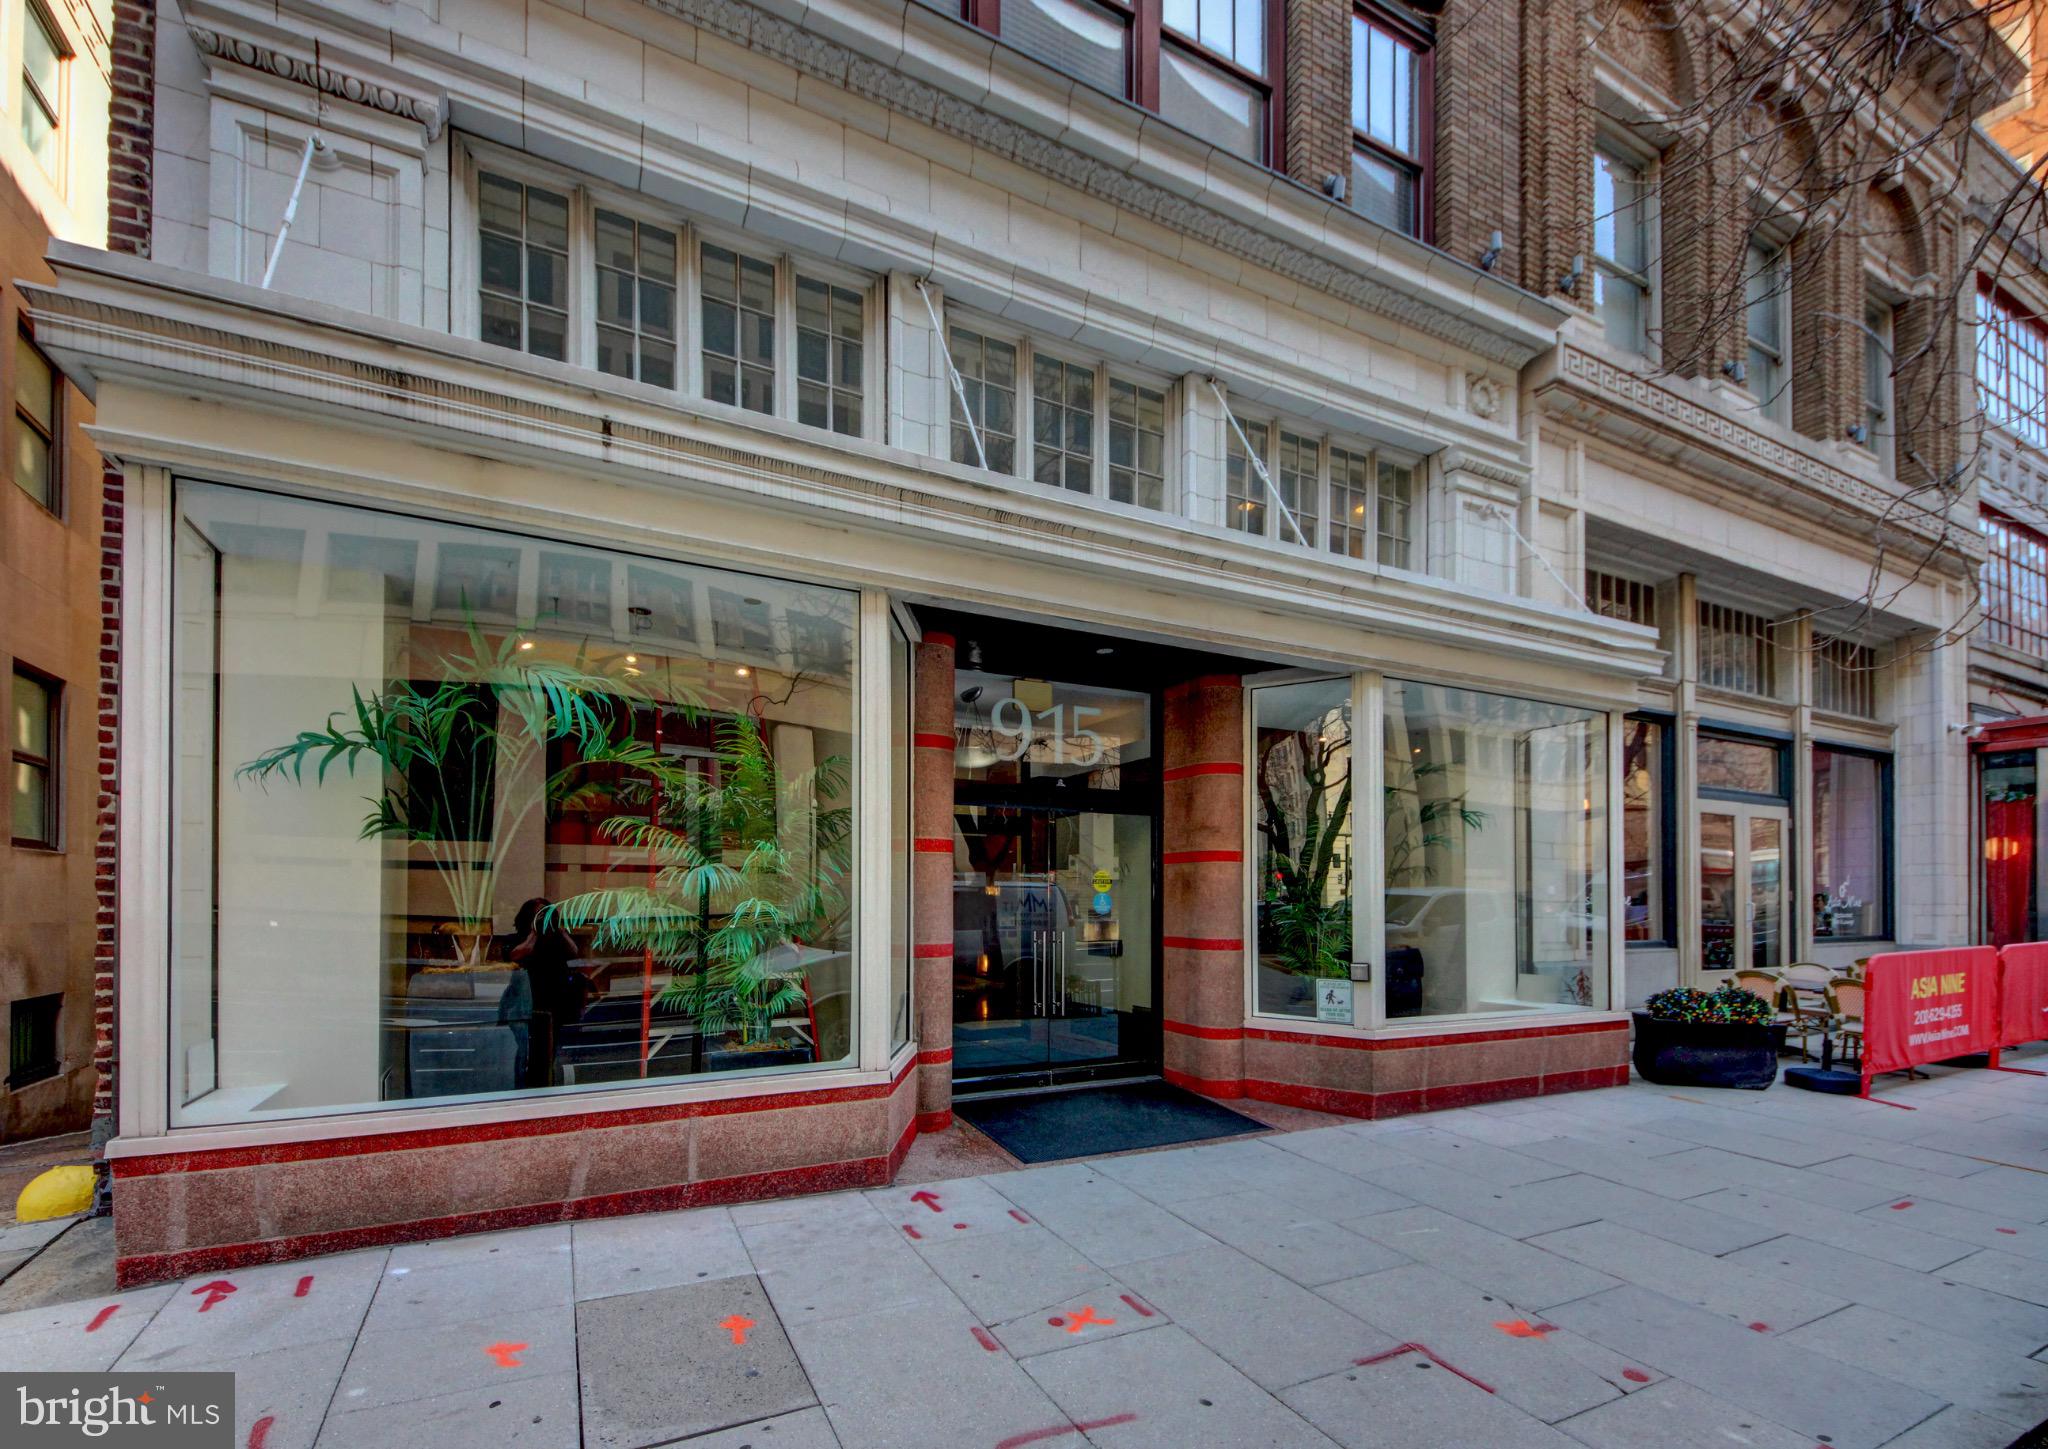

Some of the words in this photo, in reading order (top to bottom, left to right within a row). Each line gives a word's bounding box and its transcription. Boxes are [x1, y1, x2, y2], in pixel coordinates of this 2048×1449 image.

[991, 698, 1103, 767] 915
[1910, 976, 1938, 1000] ASIA
[1940, 972, 1966, 996] NINE
